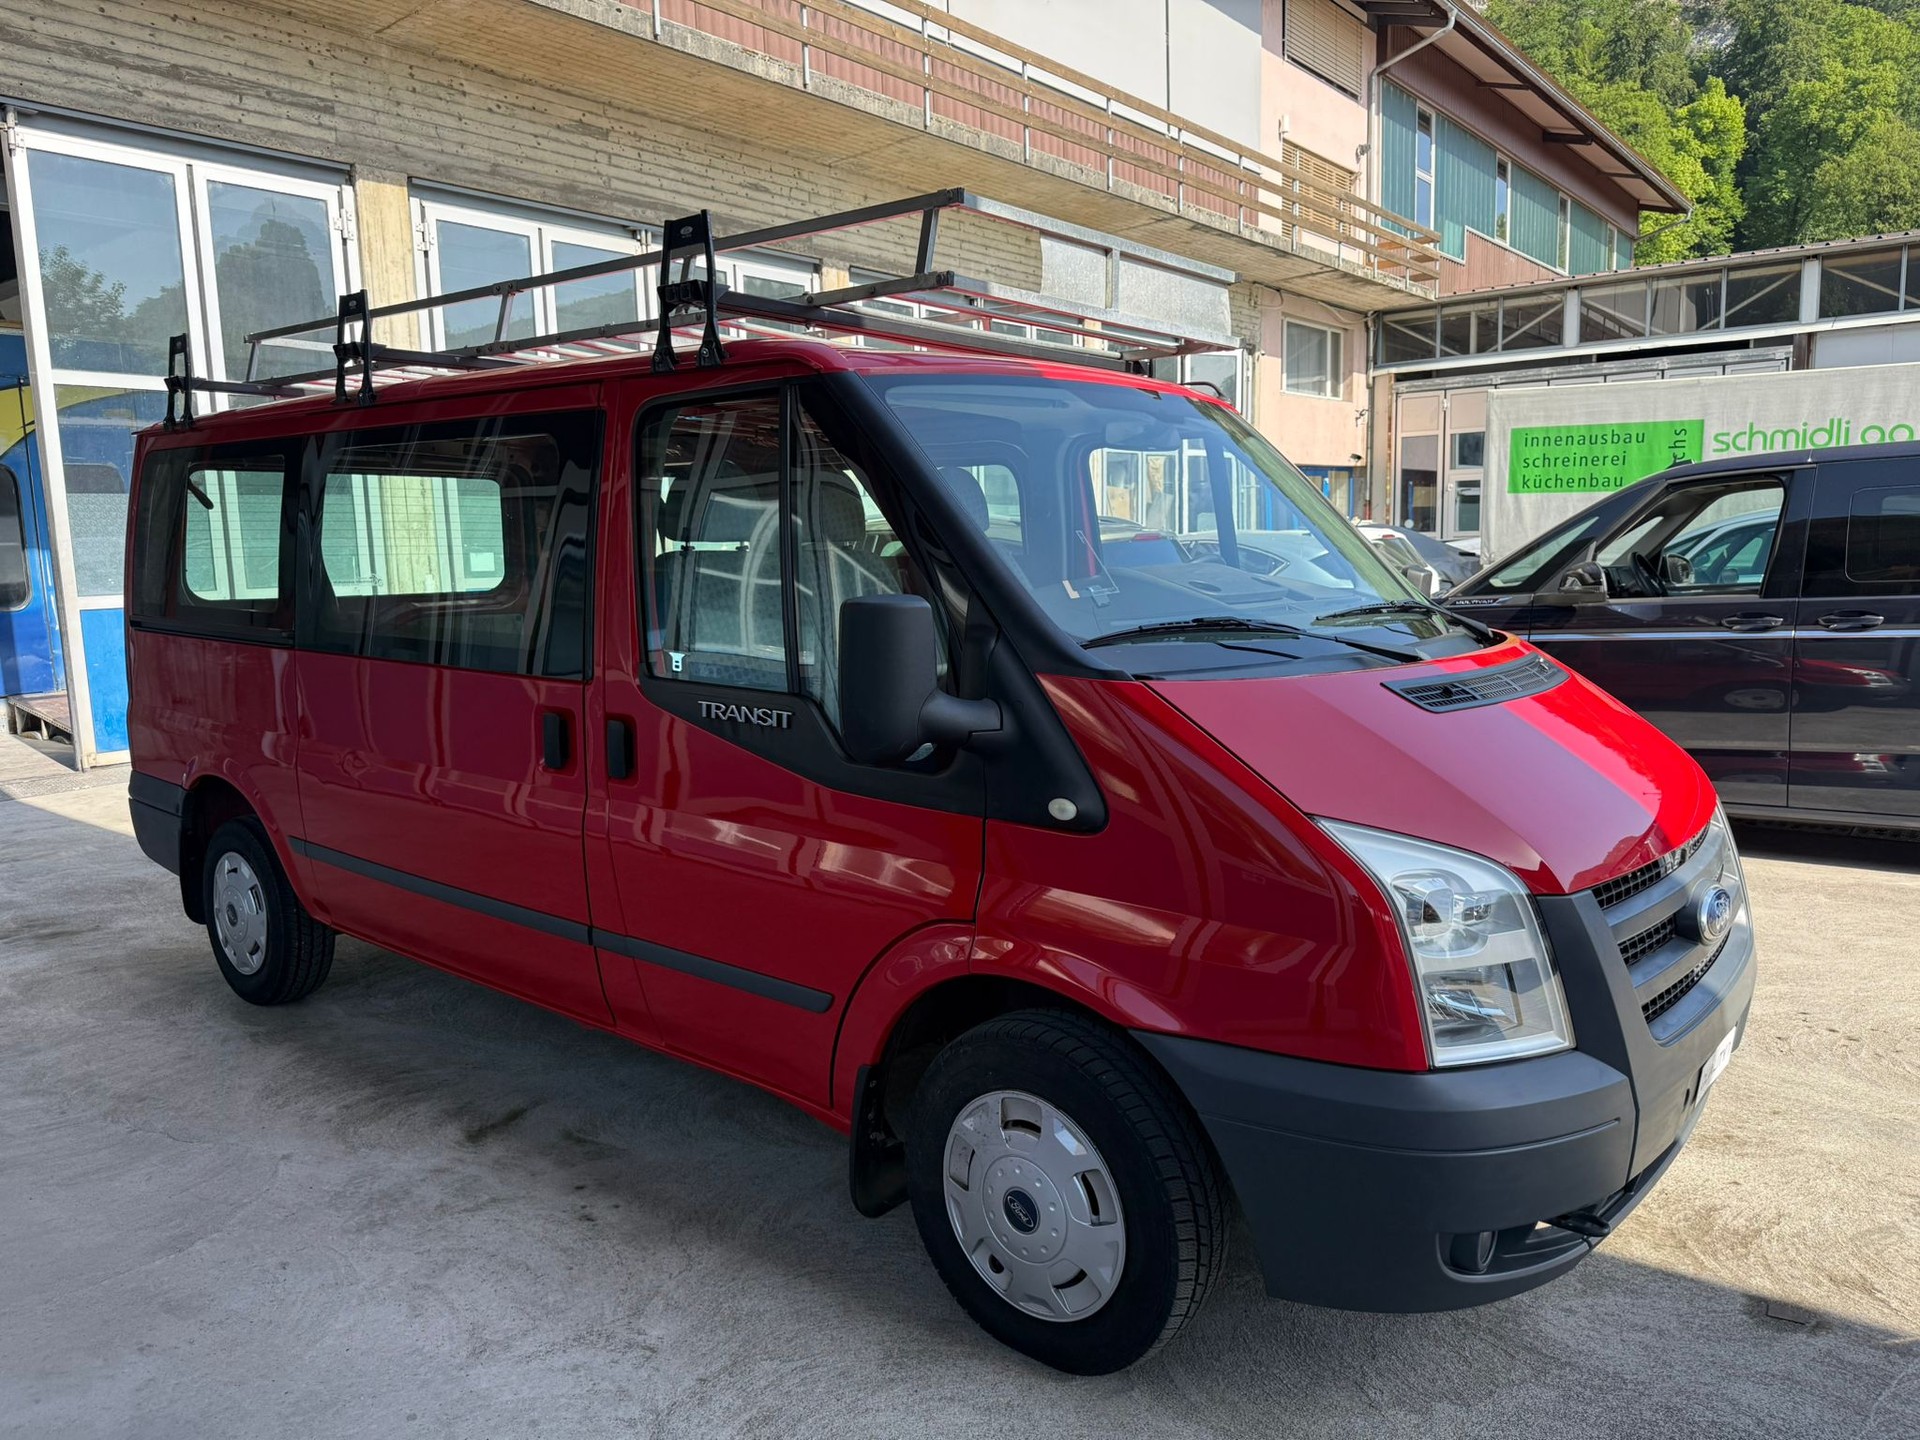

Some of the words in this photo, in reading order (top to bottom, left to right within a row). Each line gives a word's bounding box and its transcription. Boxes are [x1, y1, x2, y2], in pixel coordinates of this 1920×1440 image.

[1523, 429, 1646, 447] innenausbau
[1712, 418, 1850, 452] schmidli
[1522, 451, 1627, 468] schreinerei
[1521, 473, 1624, 489] küchenbau
[697, 700, 793, 729] TRANSIT
